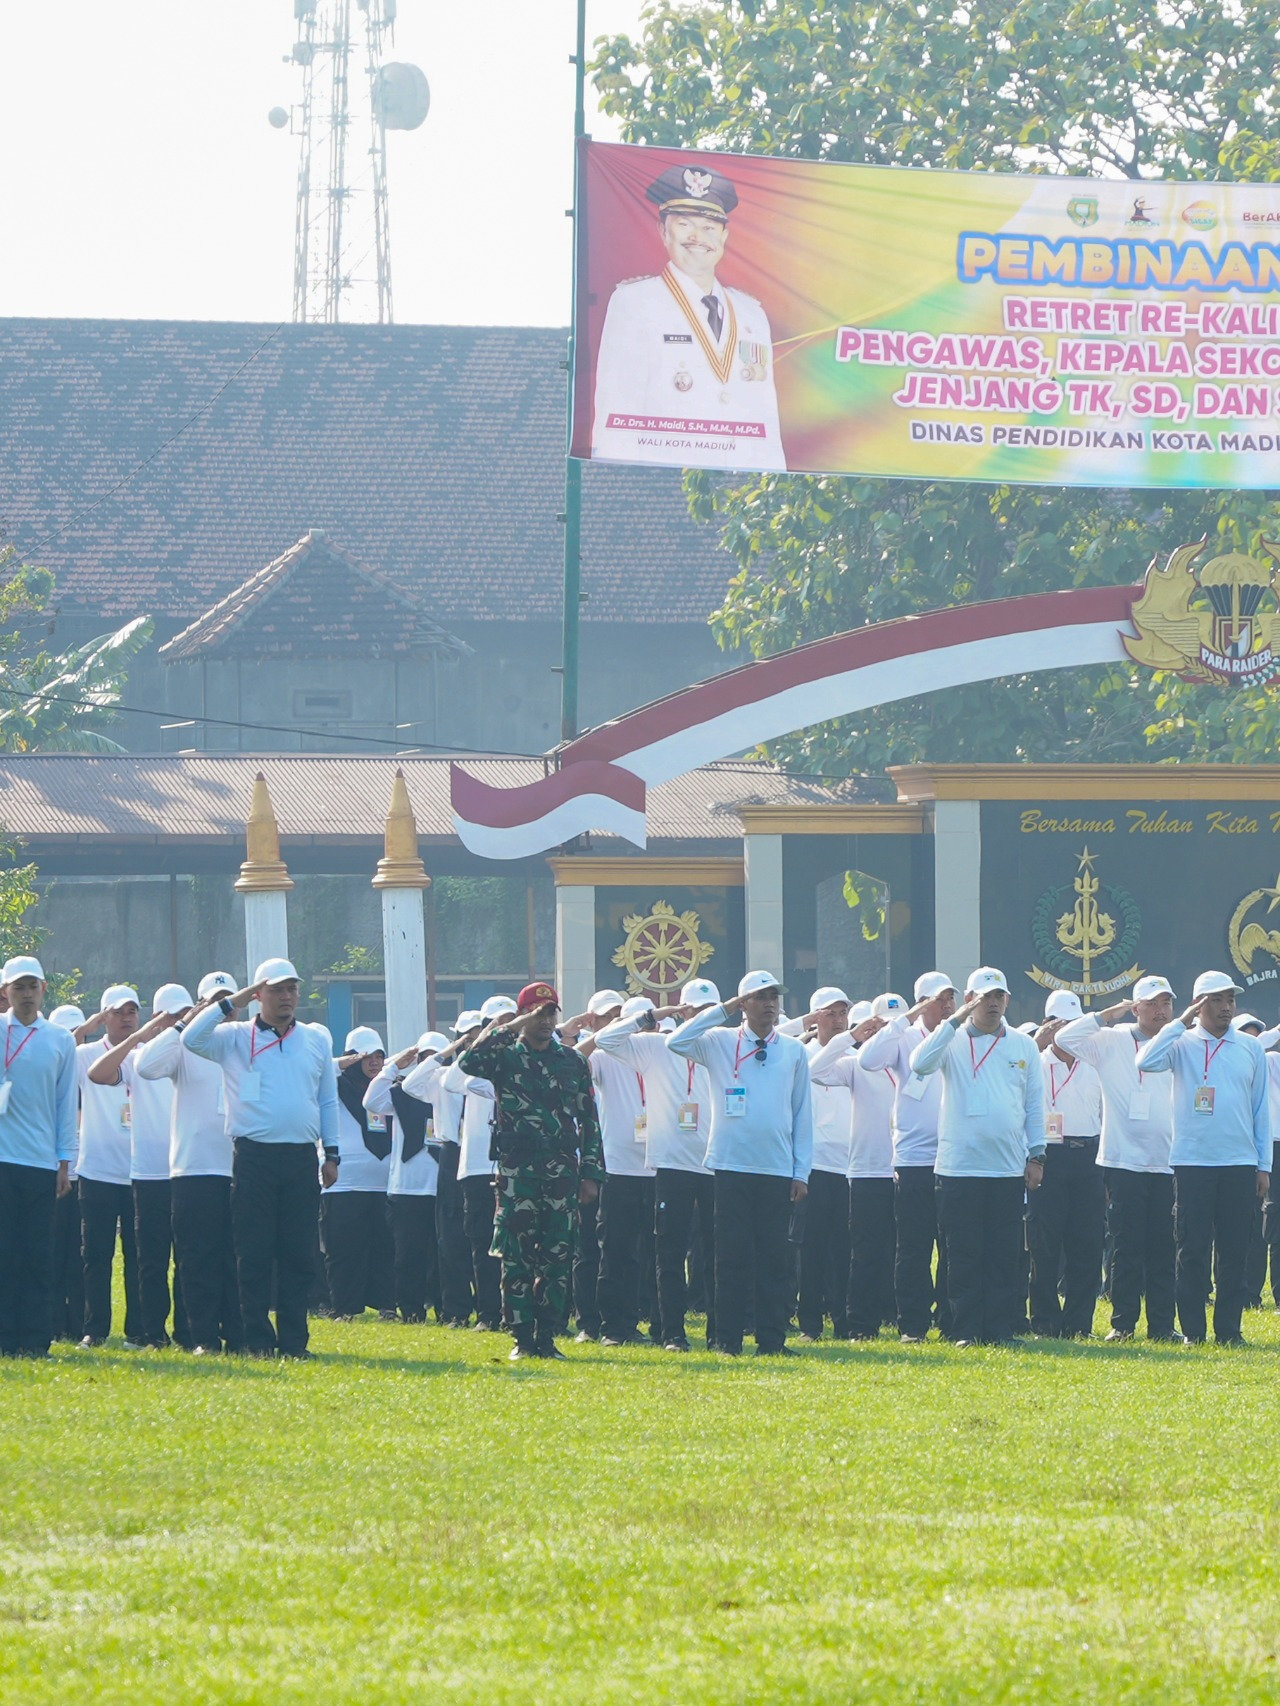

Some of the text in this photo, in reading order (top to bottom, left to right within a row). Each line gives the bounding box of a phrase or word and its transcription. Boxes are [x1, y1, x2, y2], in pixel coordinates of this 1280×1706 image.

[1007, 299, 1132, 332] RETRET
[839, 331, 1048, 375] PENGAWAS,
[1060, 342, 1189, 373] KEPALA
[897, 375, 1060, 411] JENJANG
[1069, 383, 1121, 418] TK,
[1131, 385, 1186, 420] SD,
[1196, 387, 1267, 416] DAN
[613, 417, 760, 435] Dr. Drs. H. Maidi, S.H., M.M., M.Pd.
[911, 422, 984, 443] DINAS
[993, 427, 1143, 449] PENDIDIKAN
[1152, 432, 1213, 450] KOTA
[637, 437, 736, 450] WALI KOTA MADIUN
[1201, 647, 1272, 673] PARA RAIDER
[1019, 809, 1116, 833] Bersama
[1125, 809, 1194, 833] Tuhan
[1206, 810, 1259, 834] Kita
[1104, 974, 1133, 992] YUDHA
[1246, 969, 1278, 986] BAJRA
